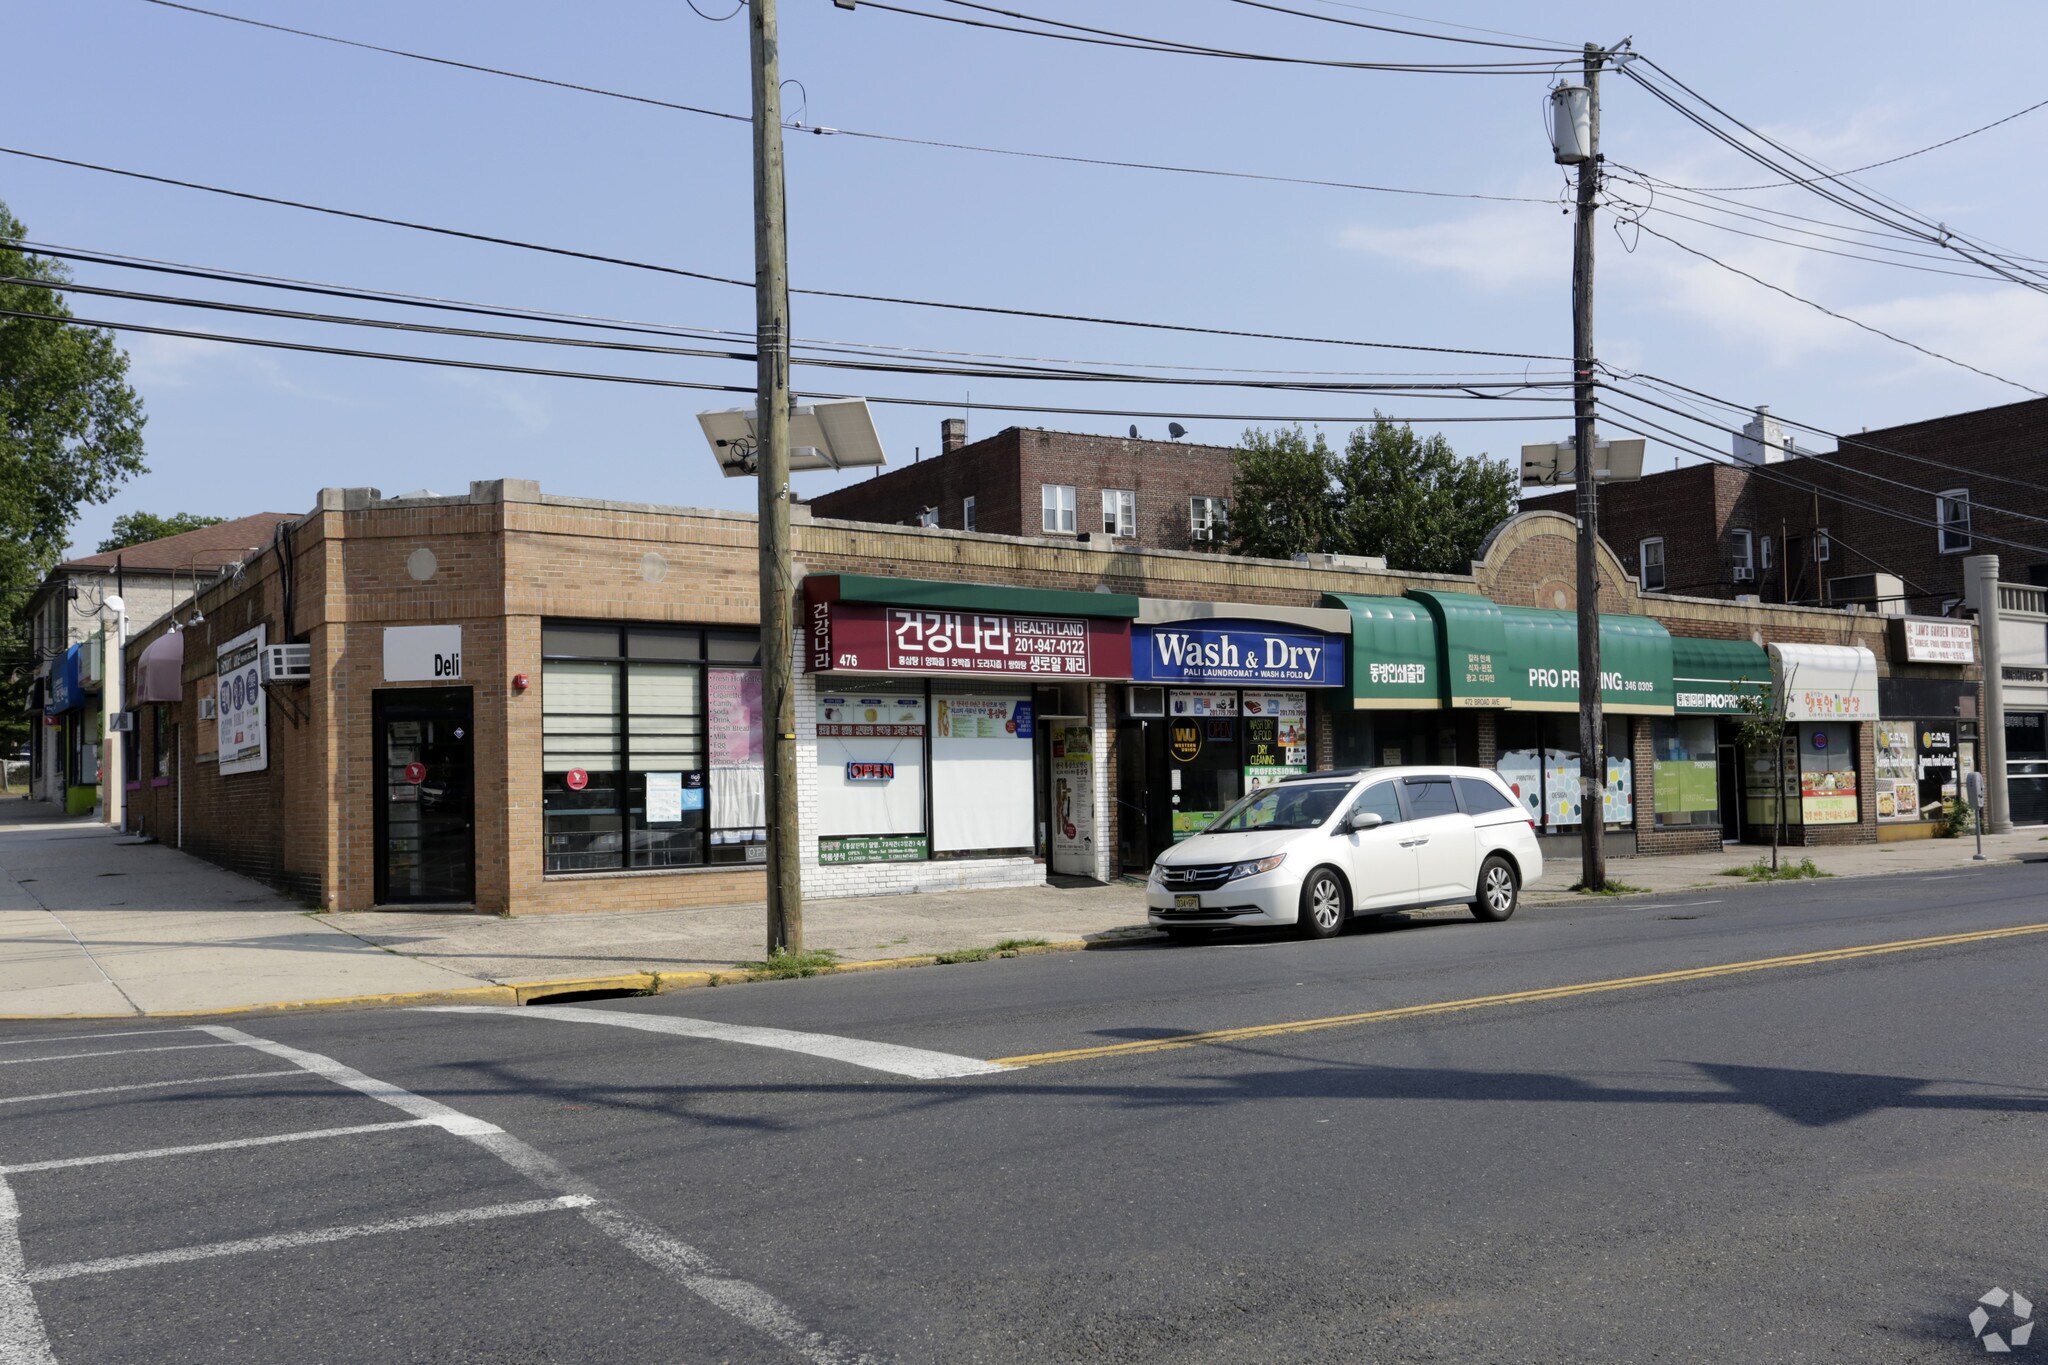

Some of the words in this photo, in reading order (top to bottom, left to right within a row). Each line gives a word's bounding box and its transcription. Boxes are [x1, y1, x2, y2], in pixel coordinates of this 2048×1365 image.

[814, 602, 830, 667] 건강나라
[895, 612, 1011, 654] 건강나라
[1014, 621, 1053, 635] HEALTH
[1057, 622, 1084, 636] LAND
[1015, 638, 1085, 654] 201-947-0122
[839, 654, 858, 666] 476
[1155, 633, 1240, 667] Wash
[1245, 651, 1259, 668] &
[1263, 638, 1321, 680] Dry
[434, 653, 460, 677] Deli
[1029, 656, 1061, 672] 생로얄
[1065, 657, 1086, 673] 제리
[1183, 668, 1201, 676] PALI
[1202, 669, 1254, 678] LAUNDROMAT
[1260, 670, 1280, 678] WASH
[1286, 671, 1303, 679] FOLD
[1369, 663, 1425, 683] 동방인쇄출판
[1479, 674, 1495, 683] 디자인
[1528, 668, 1559, 688] PRO
[1561, 669, 1623, 690] PRING
[1624, 680, 1637, 691] 346
[1637, 681, 1654, 692] 0305
[1474, 698, 1490, 706] BROAD
[1491, 698, 1500, 706] AVE
[1804, 692, 1834, 713] 행복한
[1842, 696, 1860, 713] 밥상
[1257, 744, 1268, 755] DRY
[1250, 755, 1275, 765] CLEANING
[851, 763, 893, 778] OPEN
[1249, 767, 1302, 775] PROFESSIONAL
